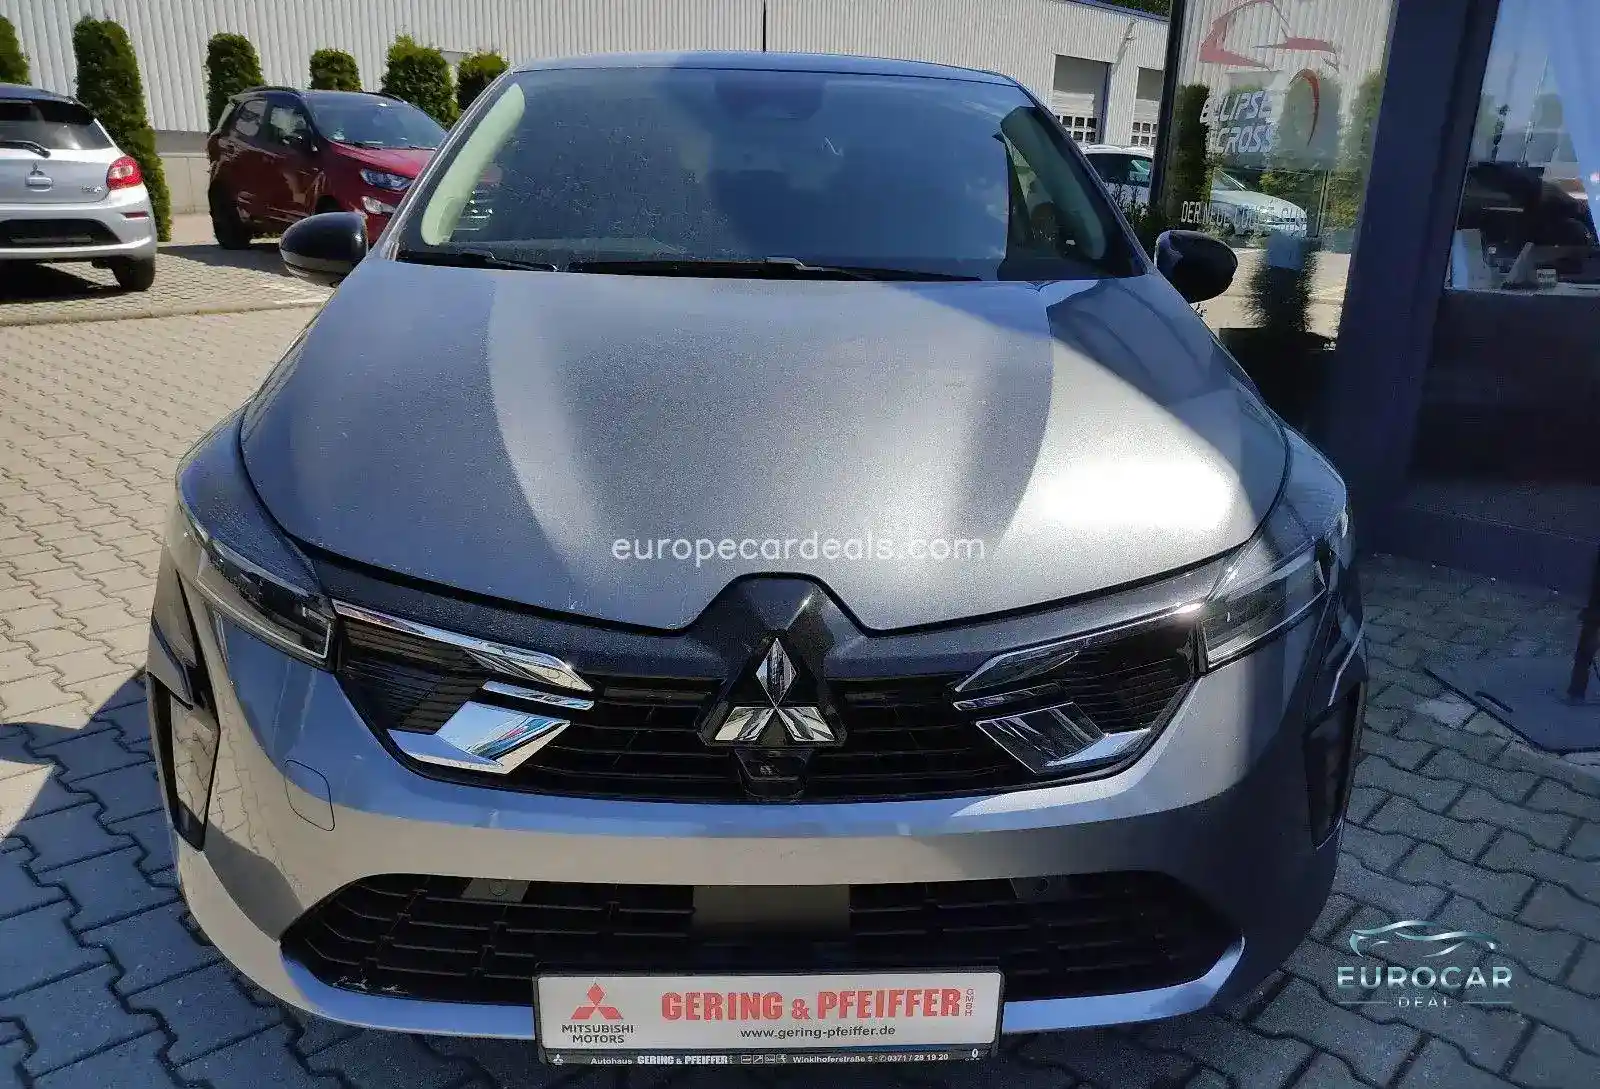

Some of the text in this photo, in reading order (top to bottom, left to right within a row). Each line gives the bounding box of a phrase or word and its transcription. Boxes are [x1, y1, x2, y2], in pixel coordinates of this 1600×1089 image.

[1180, 200, 1201, 224] DER
[661, 988, 961, 1021] GERING & PFEIFFER
[964, 988, 975, 1017] GMBH
[561, 1024, 634, 1034] MITSUBISHI
[740, 1024, 897, 1040] www.gering-pfeiffer.de
[572, 1035, 625, 1044] MOTORS
[590, 1057, 633, 1065] Autohaus
[637, 1055, 675, 1065] GERING
[684, 1055, 728, 1065] PFEIFFER
[792, 1055, 865, 1063] Winklhoferstraße
[914, 1053, 925, 1062] 28
[939, 1053, 949, 1061] 20
